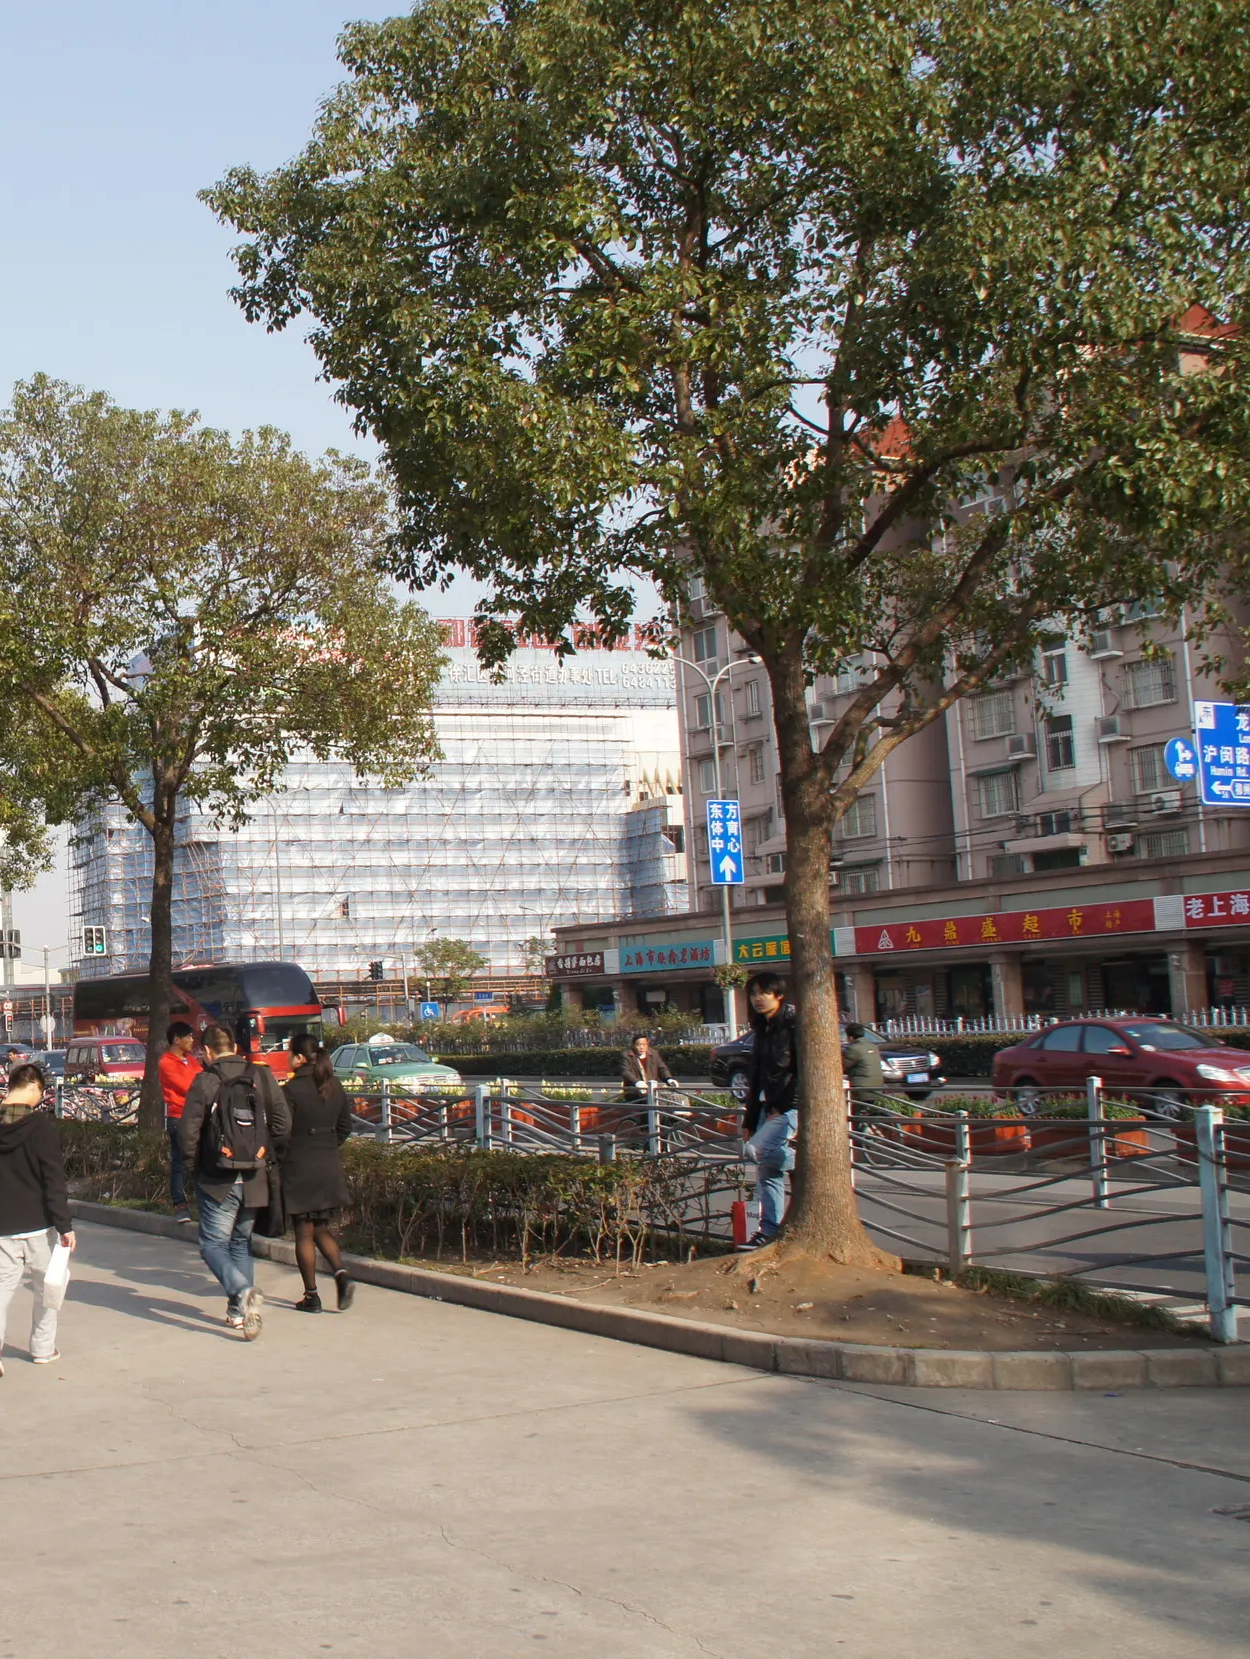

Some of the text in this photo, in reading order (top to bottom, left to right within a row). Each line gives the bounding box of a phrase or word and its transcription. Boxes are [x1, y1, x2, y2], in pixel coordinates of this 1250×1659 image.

[449, 664, 593, 685] 徐汇区河泾街道办事处
[709, 803, 739, 819] 东方
[710, 820, 739, 836] 体育
[711, 837, 741, 854] 中心
[1186, 893, 1250, 919] 老上海
